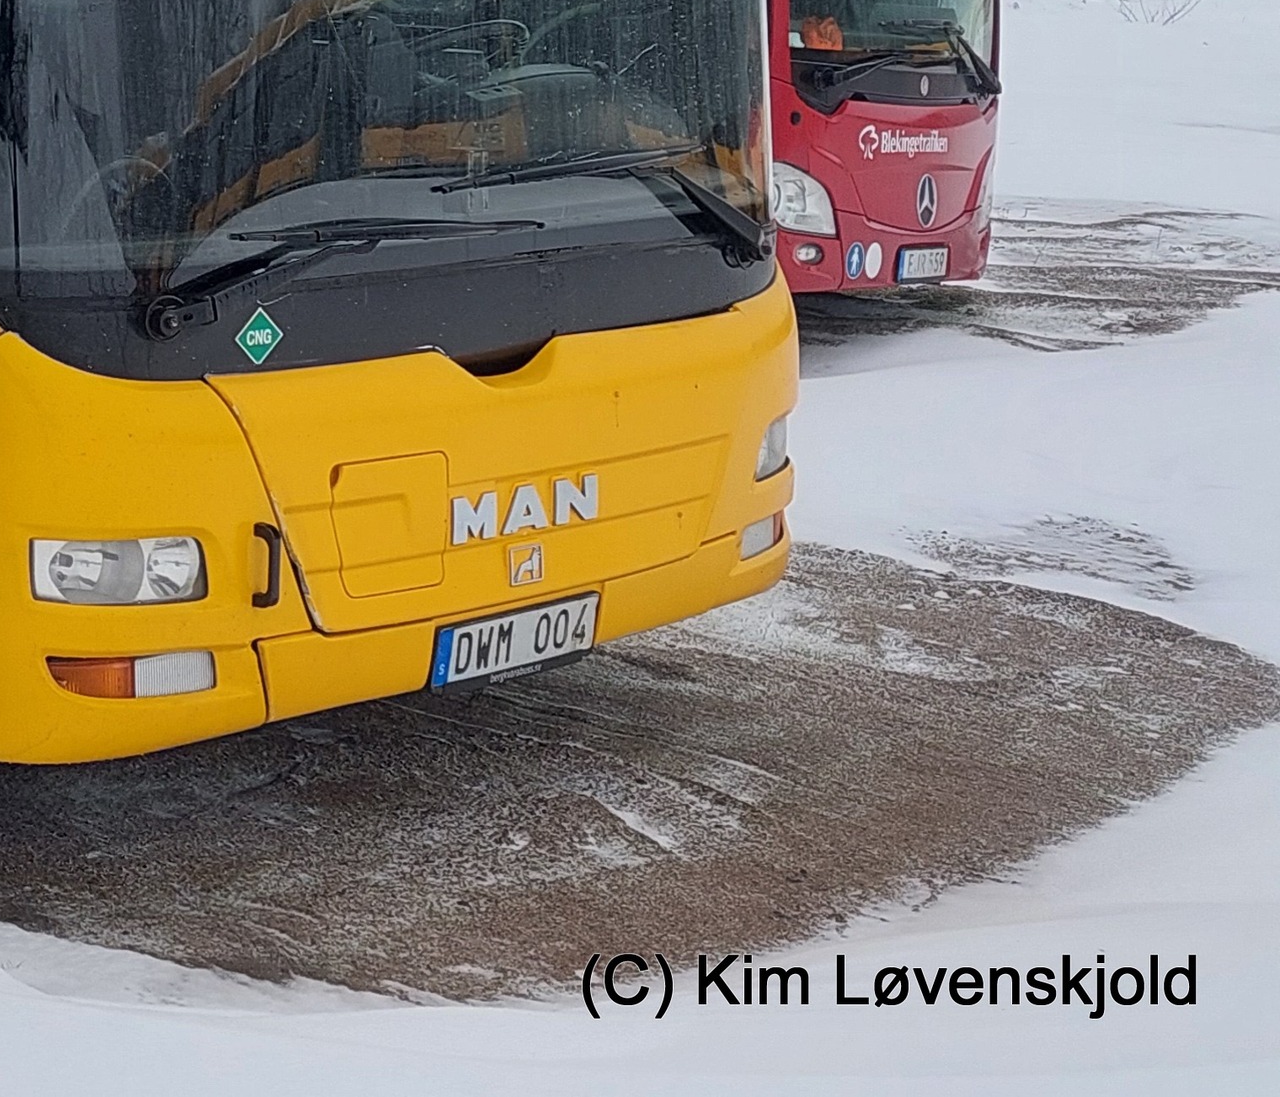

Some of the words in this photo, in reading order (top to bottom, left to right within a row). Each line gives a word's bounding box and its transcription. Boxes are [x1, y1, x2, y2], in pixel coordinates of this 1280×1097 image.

[881, 129, 948, 158] Blekingetrafiken
[246, 327, 272, 347] CNG
[450, 472, 599, 547] MAN
[454, 620, 514, 675] DWM
[533, 604, 589, 654] 004
[438, 663, 446, 676] S
